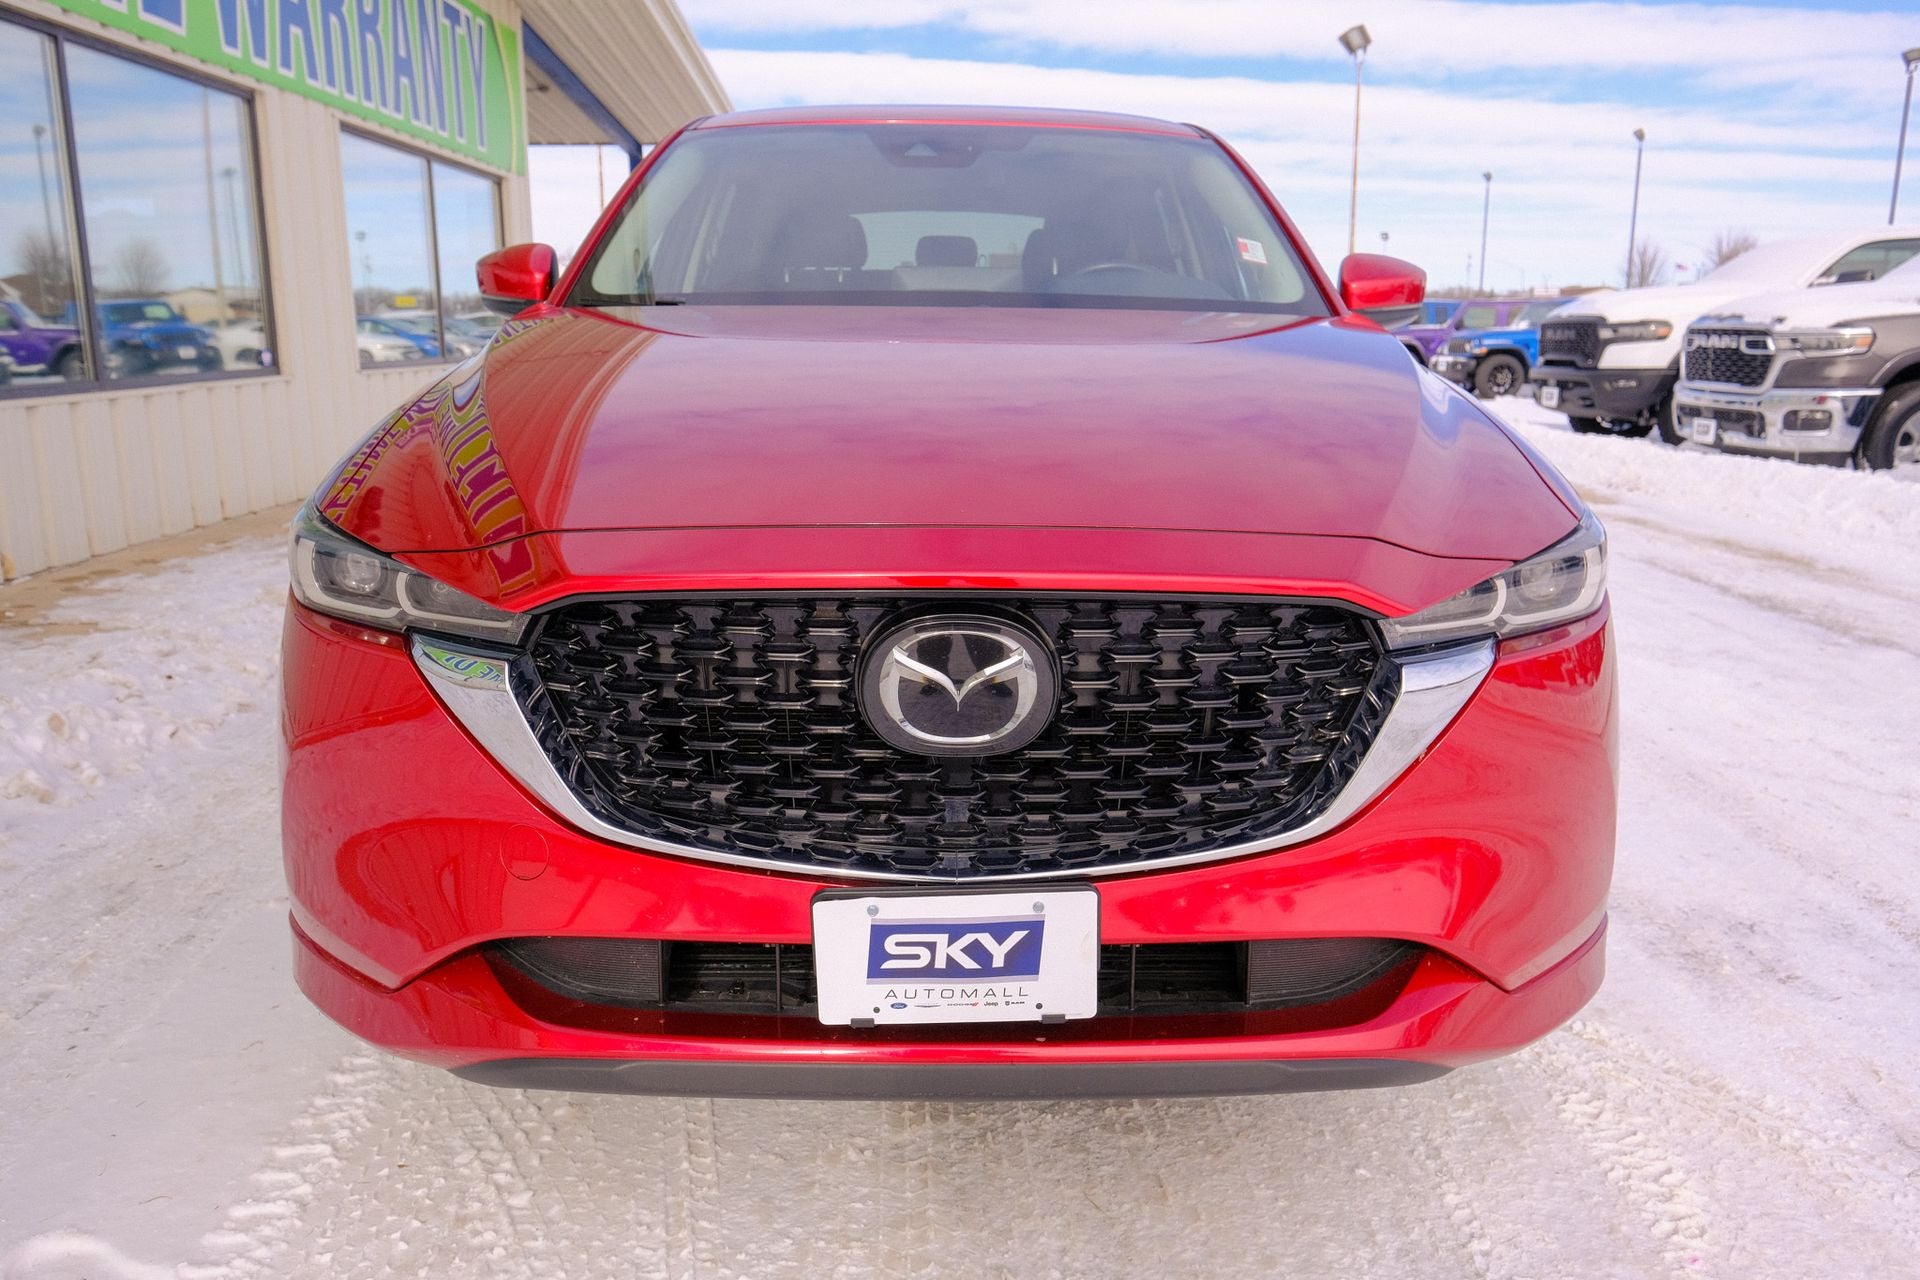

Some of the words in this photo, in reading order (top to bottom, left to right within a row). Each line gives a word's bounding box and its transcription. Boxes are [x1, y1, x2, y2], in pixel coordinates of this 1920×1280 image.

[1695, 334, 1739, 349] RAM
[880, 930, 1030, 969] SKY
[884, 986, 1029, 1000] AUTOMALL
